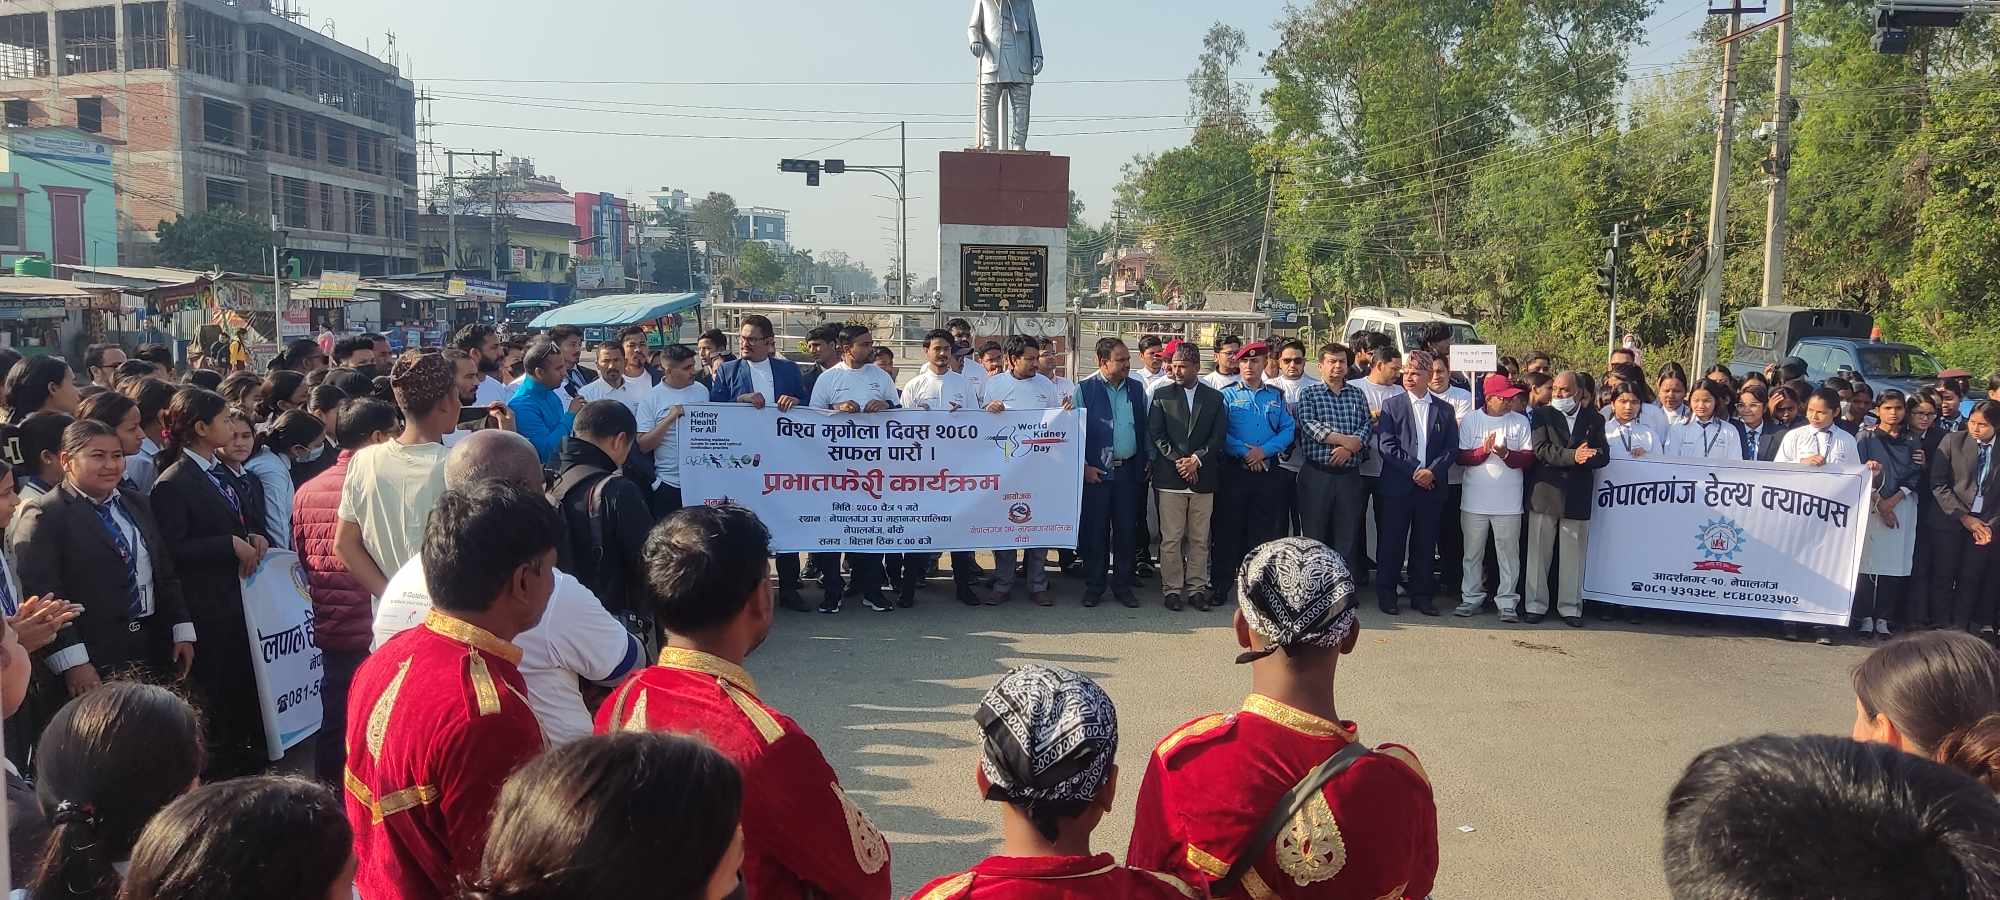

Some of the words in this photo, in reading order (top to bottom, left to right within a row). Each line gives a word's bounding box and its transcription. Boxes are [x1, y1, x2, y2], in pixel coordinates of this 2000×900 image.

[690, 411, 718, 419] Kidney
[776, 417, 817, 438] विश्व
[821, 420, 881, 443] मृगौला
[886, 420, 931, 440] दिवस
[935, 425, 978, 439] २०८०
[1018, 422, 1048, 430] World
[1033, 430, 1067, 438] Kidney
[828, 445, 882, 461] सफल
[1033, 445, 1051, 453] Day
[889, 468, 1001, 494] कार्यक्रम
[1598, 475, 1698, 508] नेपालगंज
[1704, 473, 1755, 508] हेल्थ
[1761, 484, 1850, 528] क्याम्पस
